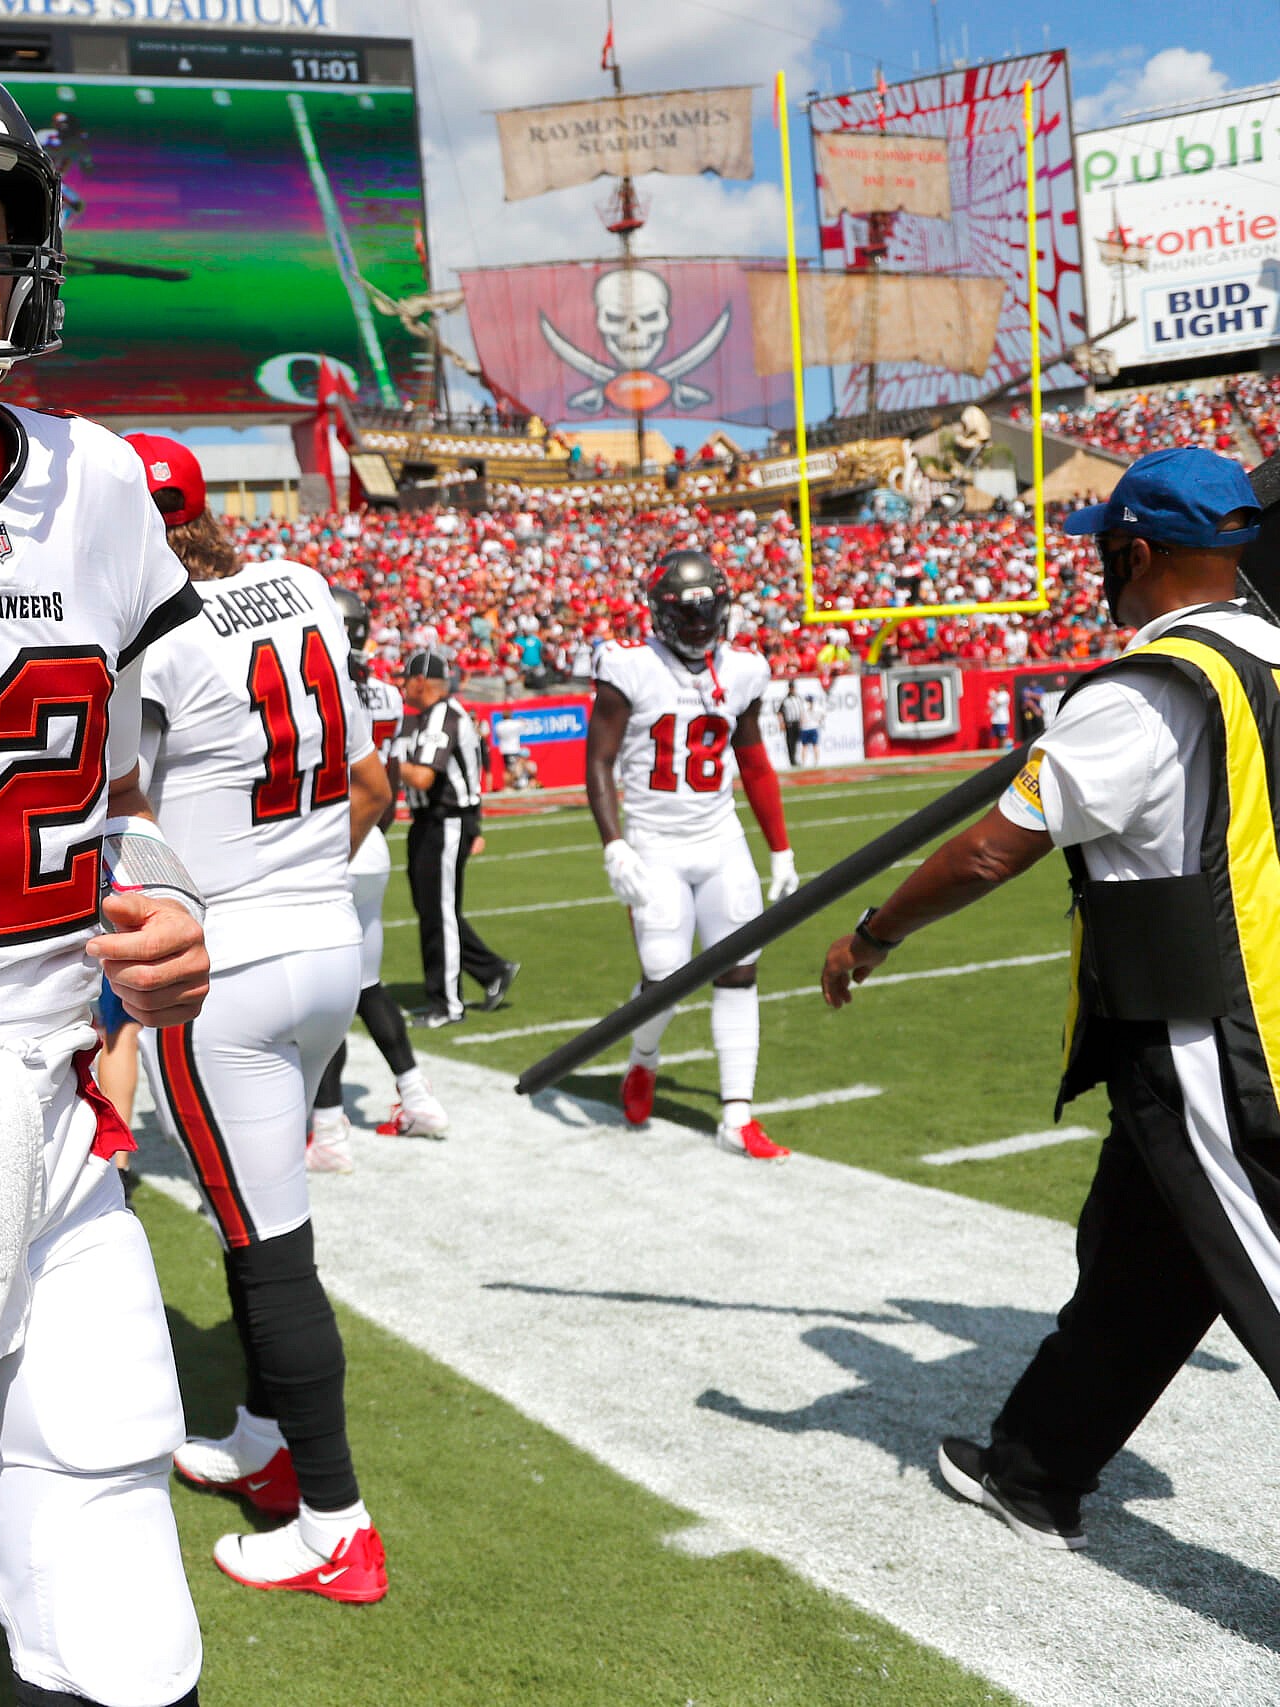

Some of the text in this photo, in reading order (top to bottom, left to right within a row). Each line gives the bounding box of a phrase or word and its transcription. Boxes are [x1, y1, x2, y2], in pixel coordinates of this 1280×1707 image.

[291, 58, 361, 81] 11:01
[529, 108, 731, 144] RAYMOND JAMES
[576, 132, 677, 154] STADIUM
[1083, 119, 1280, 193] Publi
[1168, 282, 1251, 315] BUD
[1153, 304, 1270, 343] LIGHT
[203, 576, 314, 637] GABBERT
[899, 681, 943, 722] 22
[247, 624, 349, 826] 11
[649, 713, 730, 792] 18
